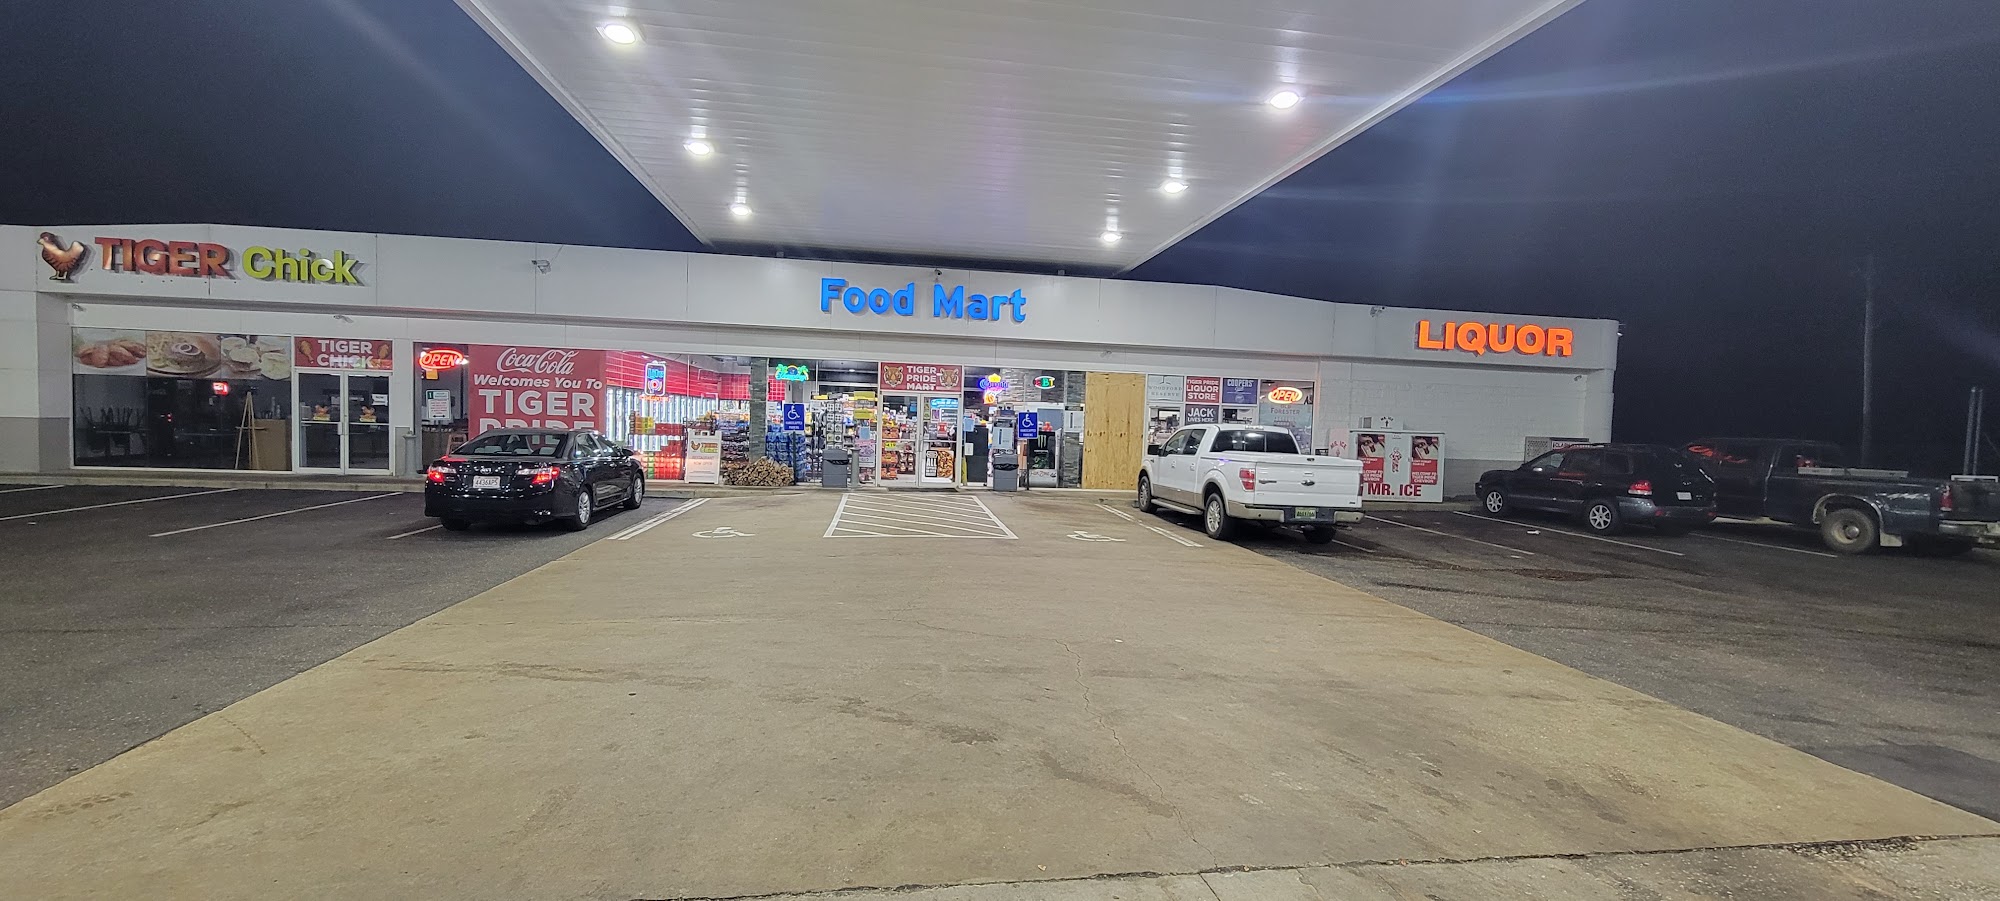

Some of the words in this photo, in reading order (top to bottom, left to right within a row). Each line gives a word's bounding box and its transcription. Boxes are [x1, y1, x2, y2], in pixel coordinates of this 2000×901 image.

[94, 237, 232, 277] TIGER
[242, 246, 358, 285] Chick
[820, 277, 915, 317] Food
[933, 283, 1027, 322] Mart
[1418, 320, 1574, 356] LIQUOR
[317, 340, 373, 354] TIGER
[316, 353, 374, 368] CHICK
[422, 353, 458, 367] OPEN
[906, 365, 937, 374] TIGER
[473, 374, 550, 387] Welcomes
[554, 377, 581, 389] You
[585, 378, 603, 390] To
[906, 374, 937, 383] PRIDE
[1034, 377, 1055, 388] EBT
[906, 383, 937, 391] MART
[1186, 385, 1219, 393] LIQUOR
[1271, 389, 1299, 402] OPEN
[478, 389, 595, 417] TIGER
[1187, 407, 1214, 418] JACK
[1367, 484, 1395, 496] MR.
[1399, 484, 1422, 497] ICE
